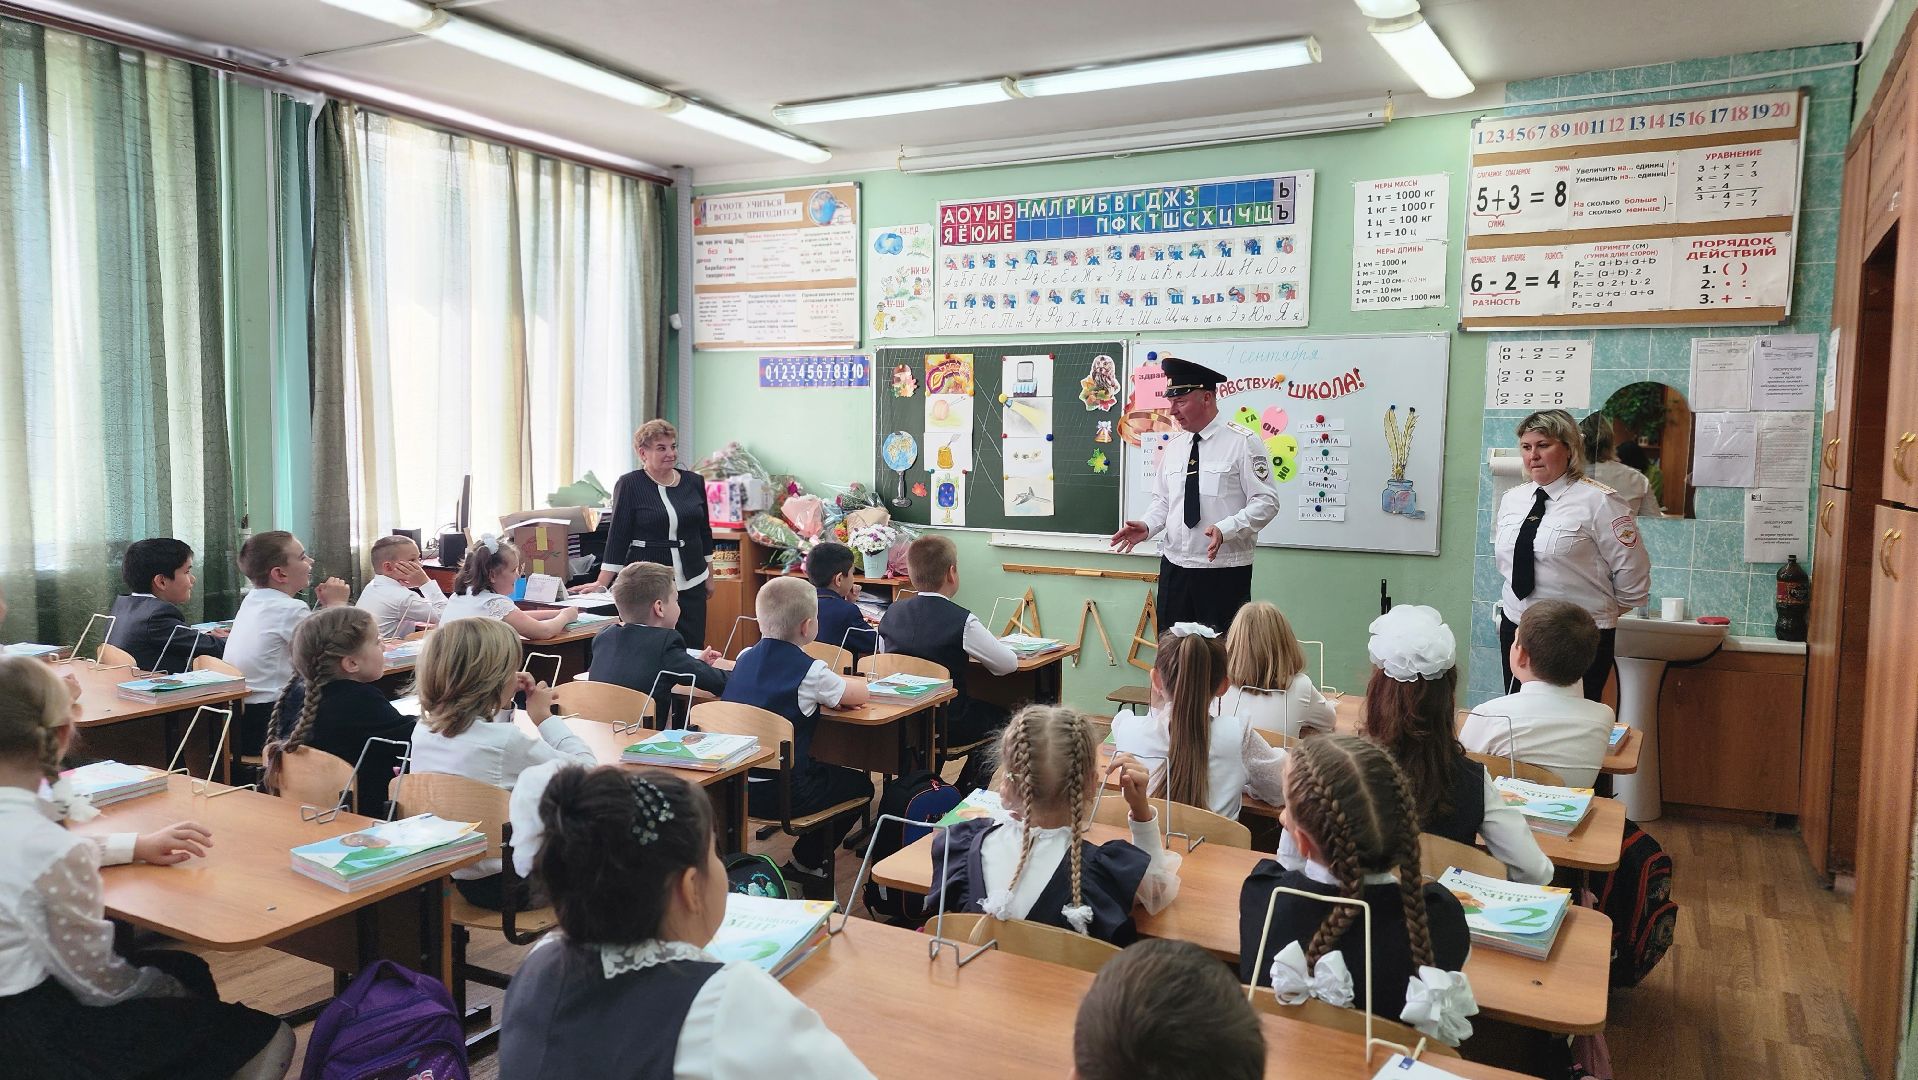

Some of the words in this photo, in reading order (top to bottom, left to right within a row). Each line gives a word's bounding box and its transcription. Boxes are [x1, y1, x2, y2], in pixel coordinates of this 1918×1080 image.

[1706, 150, 1762, 160] УРАВНЕНИЕ
[1576, 175, 1617, 183] Уменьшить
[1396, 190, 1420, 199] 1000
[1555, 181, 1566, 207] 8
[710, 202, 744, 211] ГРАМОТЕ
[747, 199, 782, 208] УЧИТЬСЯ
[1402, 202, 1426, 211] 1000
[714, 212, 742, 221] ВСЕГДА
[747, 209, 796, 219] ПРИГОДИТСЯ
[1588, 208, 1622, 216] сколько
[1400, 215, 1417, 223] 100
[1488, 220, 1504, 228] СУММА
[1693, 237, 1773, 248] ПОРЯДОК
[1397, 246, 1424, 254] ДЛИНЫ
[1686, 246, 1776, 260] ДЕЙСТВИЙ
[1702, 265, 1716, 274] 1.
[1471, 273, 1482, 292] 6
[1505, 272, 1516, 290] 2
[1526, 277, 1538, 286] =
[1547, 270, 1560, 288] 4
[1701, 280, 1715, 289] 2.
[1700, 294, 1714, 303] 3.
[1288, 367, 1365, 400] ШКОЛА!
[1542, 803, 1577, 817] 2
[1499, 907, 1548, 927] 2
